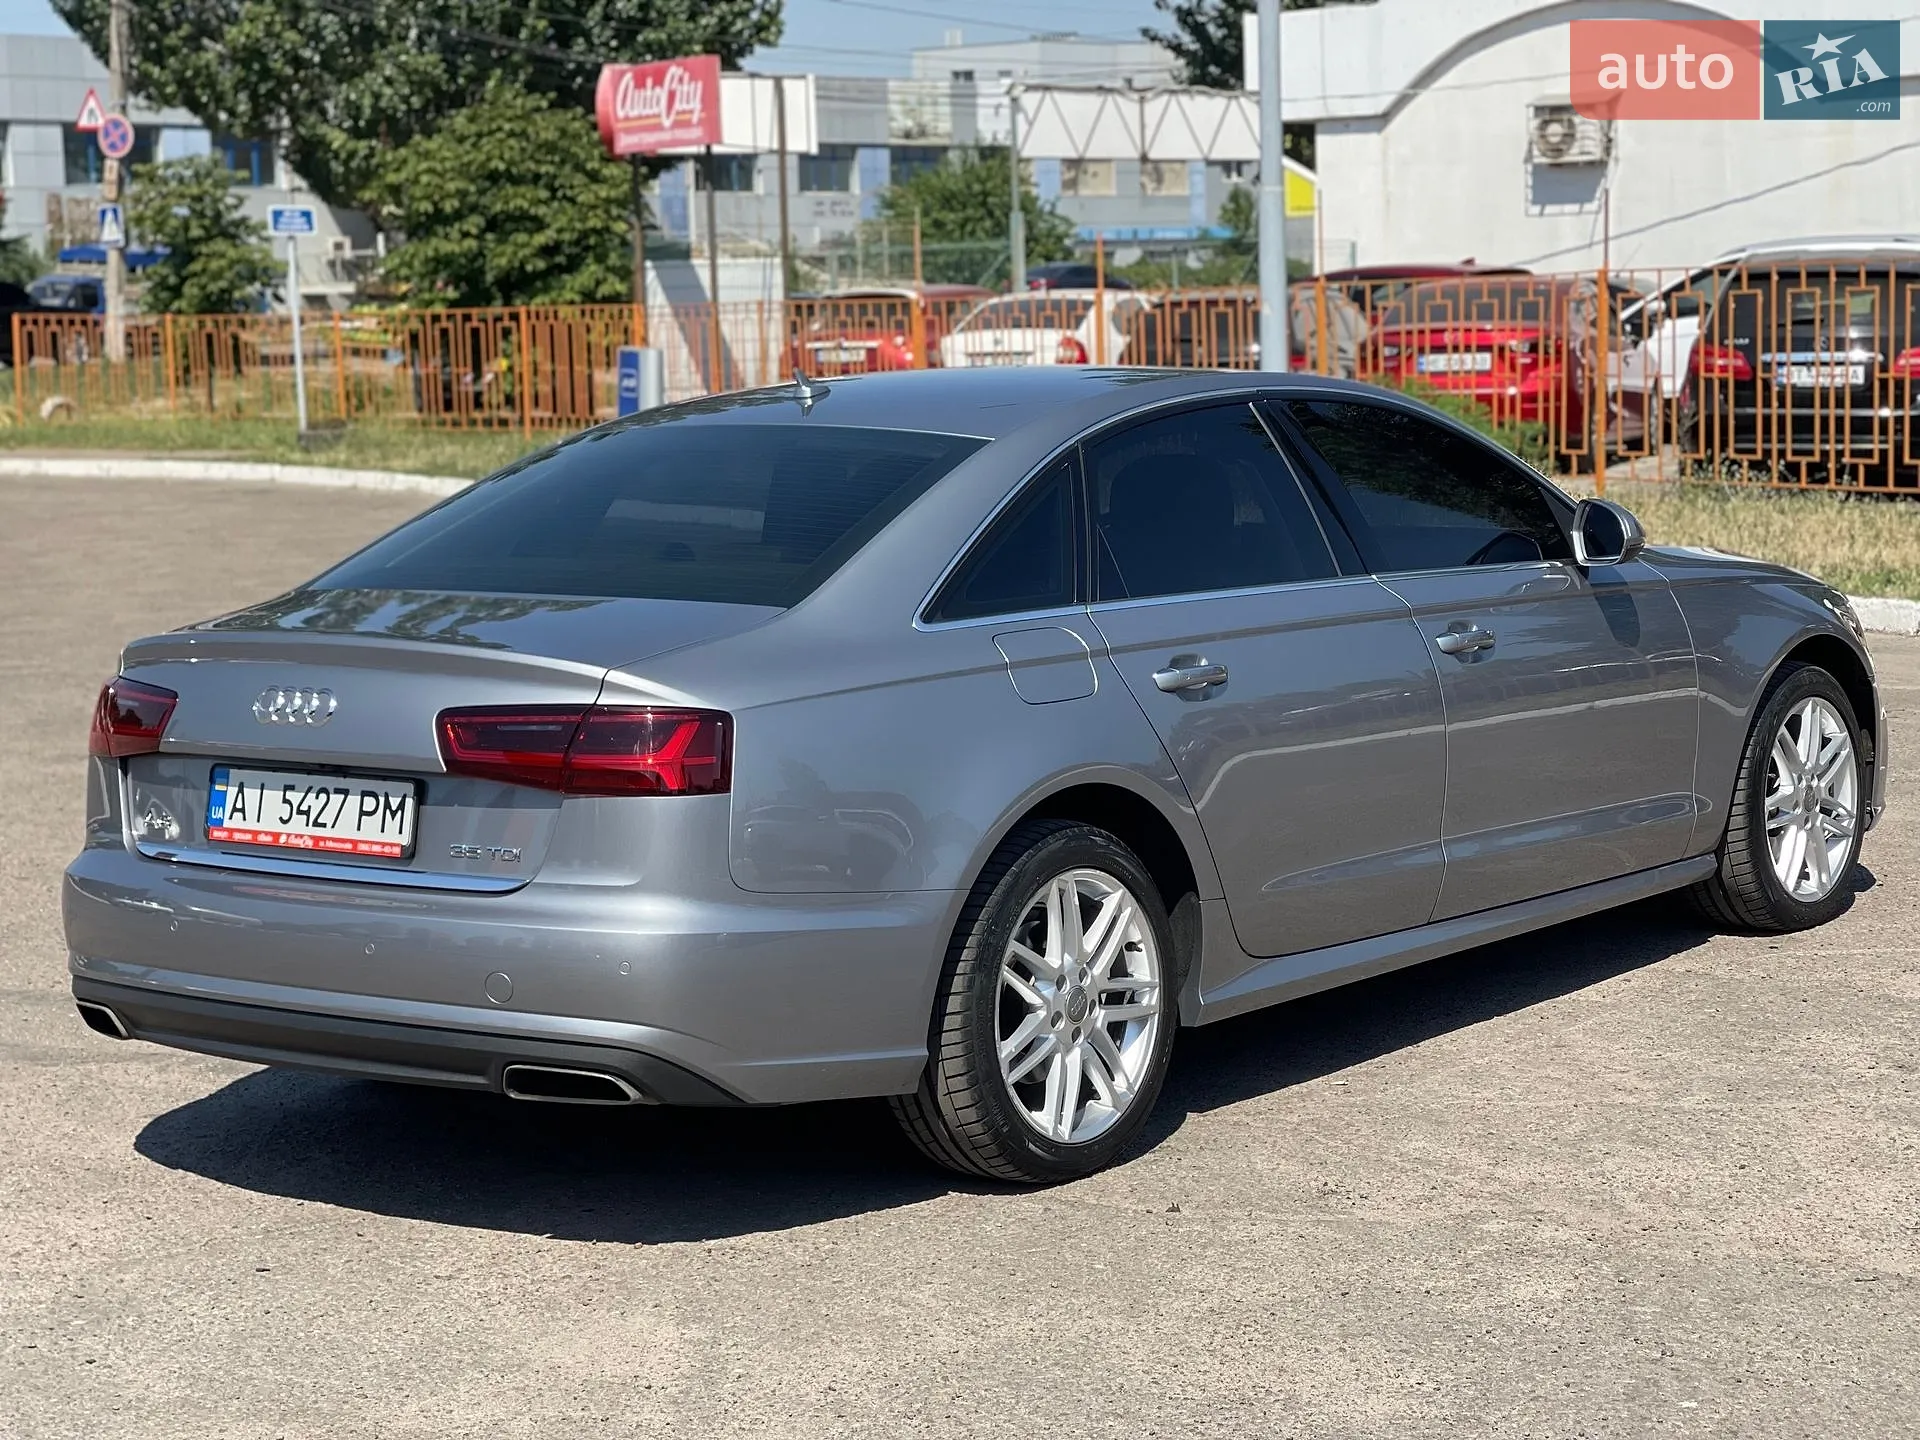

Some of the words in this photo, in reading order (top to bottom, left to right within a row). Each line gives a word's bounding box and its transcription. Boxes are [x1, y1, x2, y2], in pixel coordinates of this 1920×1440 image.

[616, 65, 703, 128] AutoCity
[211, 806, 224, 820] UA
[229, 781, 265, 823] AI
[278, 784, 350, 828] 5427
[356, 790, 408, 835] PM
[449, 843, 481, 860] 35
[486, 846, 522, 863] TDI
